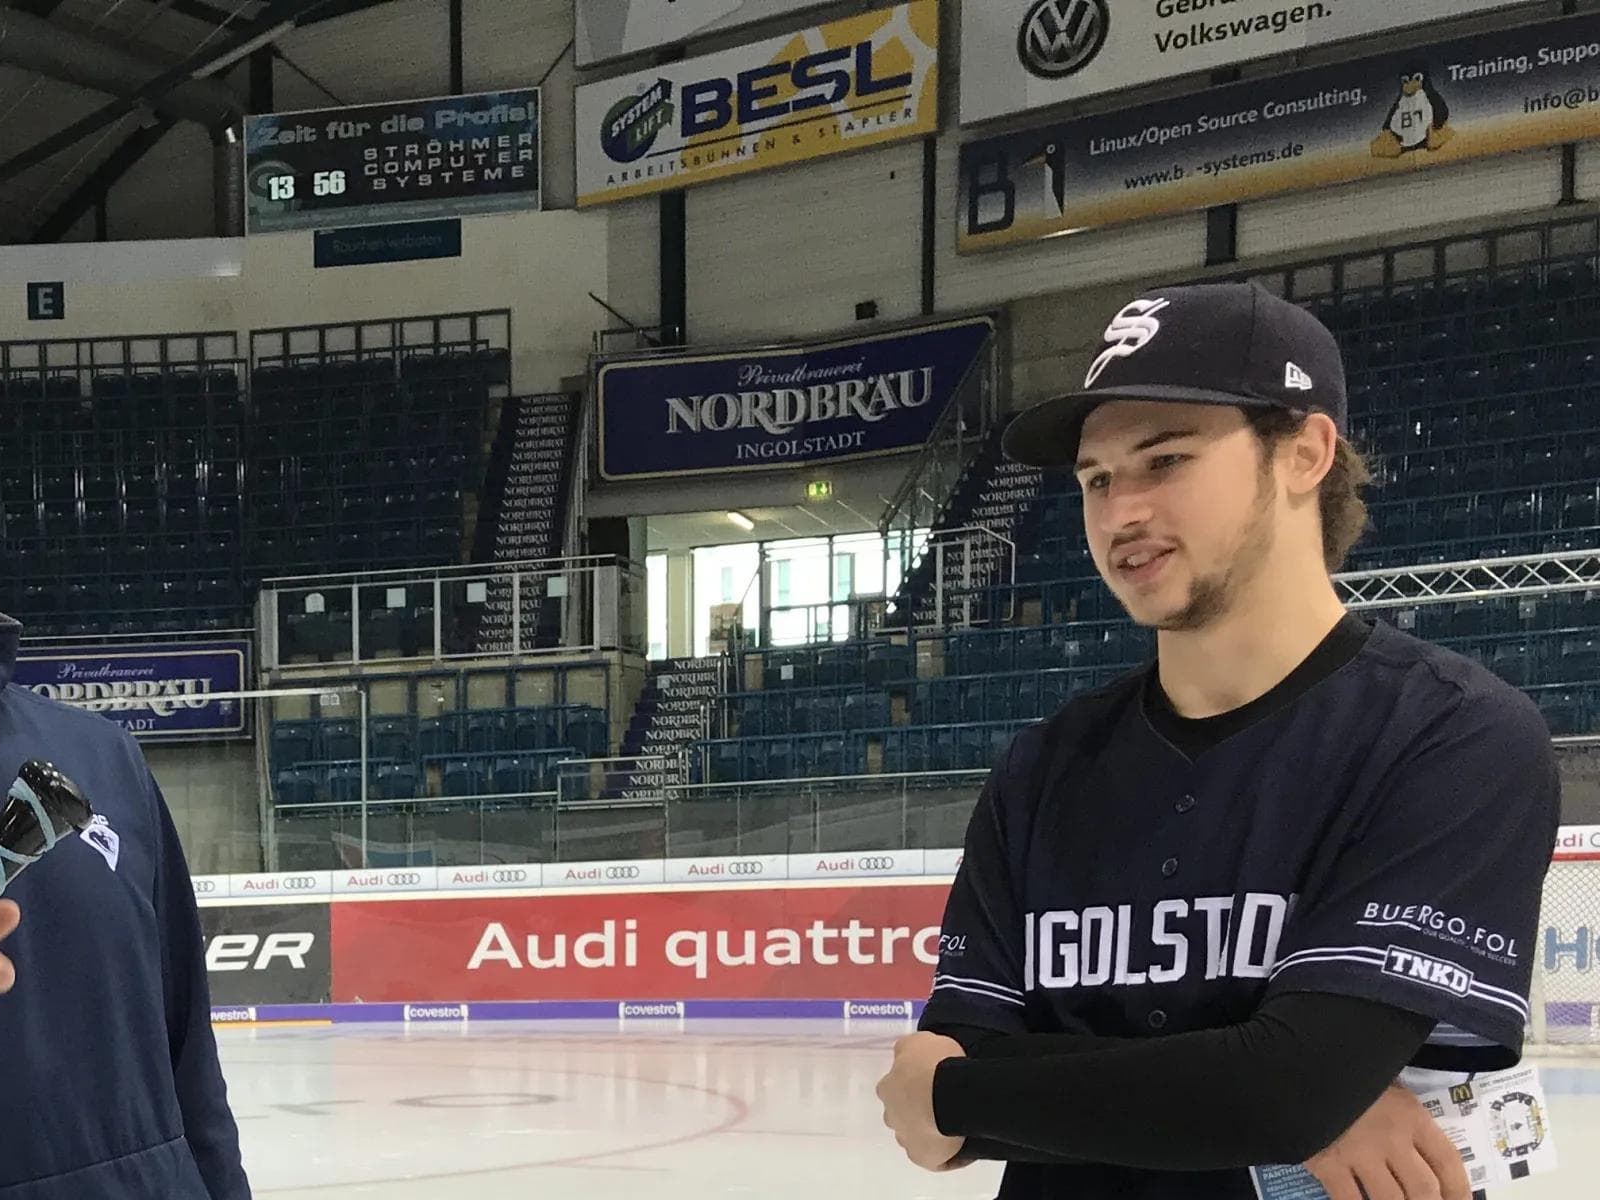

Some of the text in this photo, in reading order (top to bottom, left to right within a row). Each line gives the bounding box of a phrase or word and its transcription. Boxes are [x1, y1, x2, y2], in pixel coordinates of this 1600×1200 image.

[1154, 2, 1332, 53] Volkswagen.
[1448, 55, 1533, 82] Training,
[680, 41, 913, 138] BESL
[610, 86, 663, 138] SYSTEM
[635, 109, 666, 142] LIFT
[818, 108, 913, 139] STAPLER
[1089, 87, 1368, 155] Linux/Open Source Consulting,
[258, 124, 317, 146] Zeit
[326, 119, 371, 140] für
[380, 114, 425, 134] die
[363, 133, 532, 161] STRÖHMER
[364, 149, 533, 176] COMPUTER
[1124, 142, 1304, 190] www.b-systems.de
[268, 170, 346, 200] 13 56
[373, 165, 525, 190] SYSTEME
[38, 287, 54, 315] E
[665, 366, 935, 435] NORDBRÄU
[736, 431, 866, 459] INGOLSTADT
[22, 678, 211, 717] ORDBRÄU
[453, 871, 489, 884] Audi
[566, 868, 602, 880] Audi
[688, 863, 724, 877] Audi
[816, 858, 854, 872] Audi
[243, 878, 280, 890] Audi
[348, 874, 383, 887] Audi
[1364, 902, 1519, 957] BUERGO.FOL
[466, 919, 942, 979] Audi quattro
[1391, 952, 1469, 993] TNKD
[408, 1005, 462, 1018] covestro
[623, 1003, 679, 1017] covestro
[848, 1003, 906, 1017] covestro
